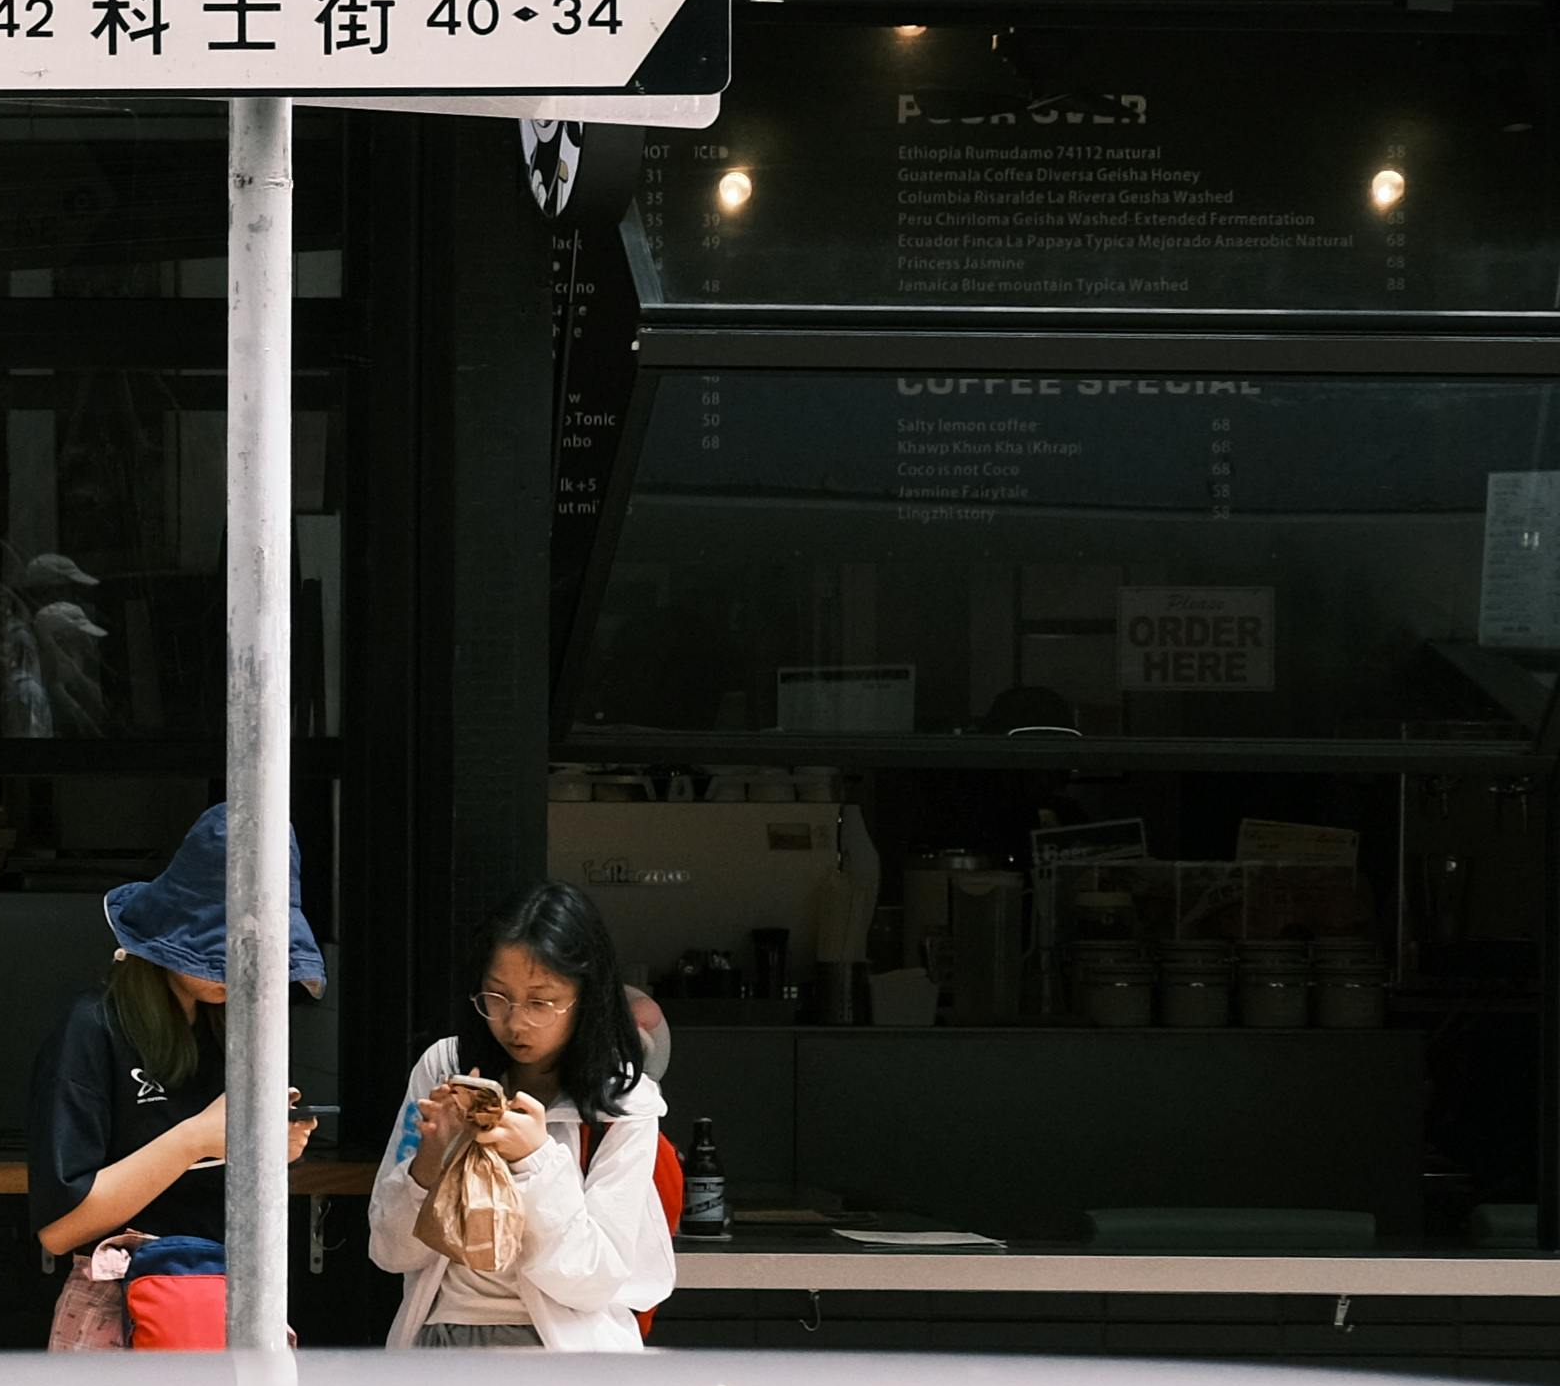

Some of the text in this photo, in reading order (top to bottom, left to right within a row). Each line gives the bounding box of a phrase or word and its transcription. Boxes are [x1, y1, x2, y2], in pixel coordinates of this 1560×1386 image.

[1210, 211, 1315, 224] Fermentation
[1128, 615, 1263, 648] ORDER
[1143, 651, 1248, 683] HERE
